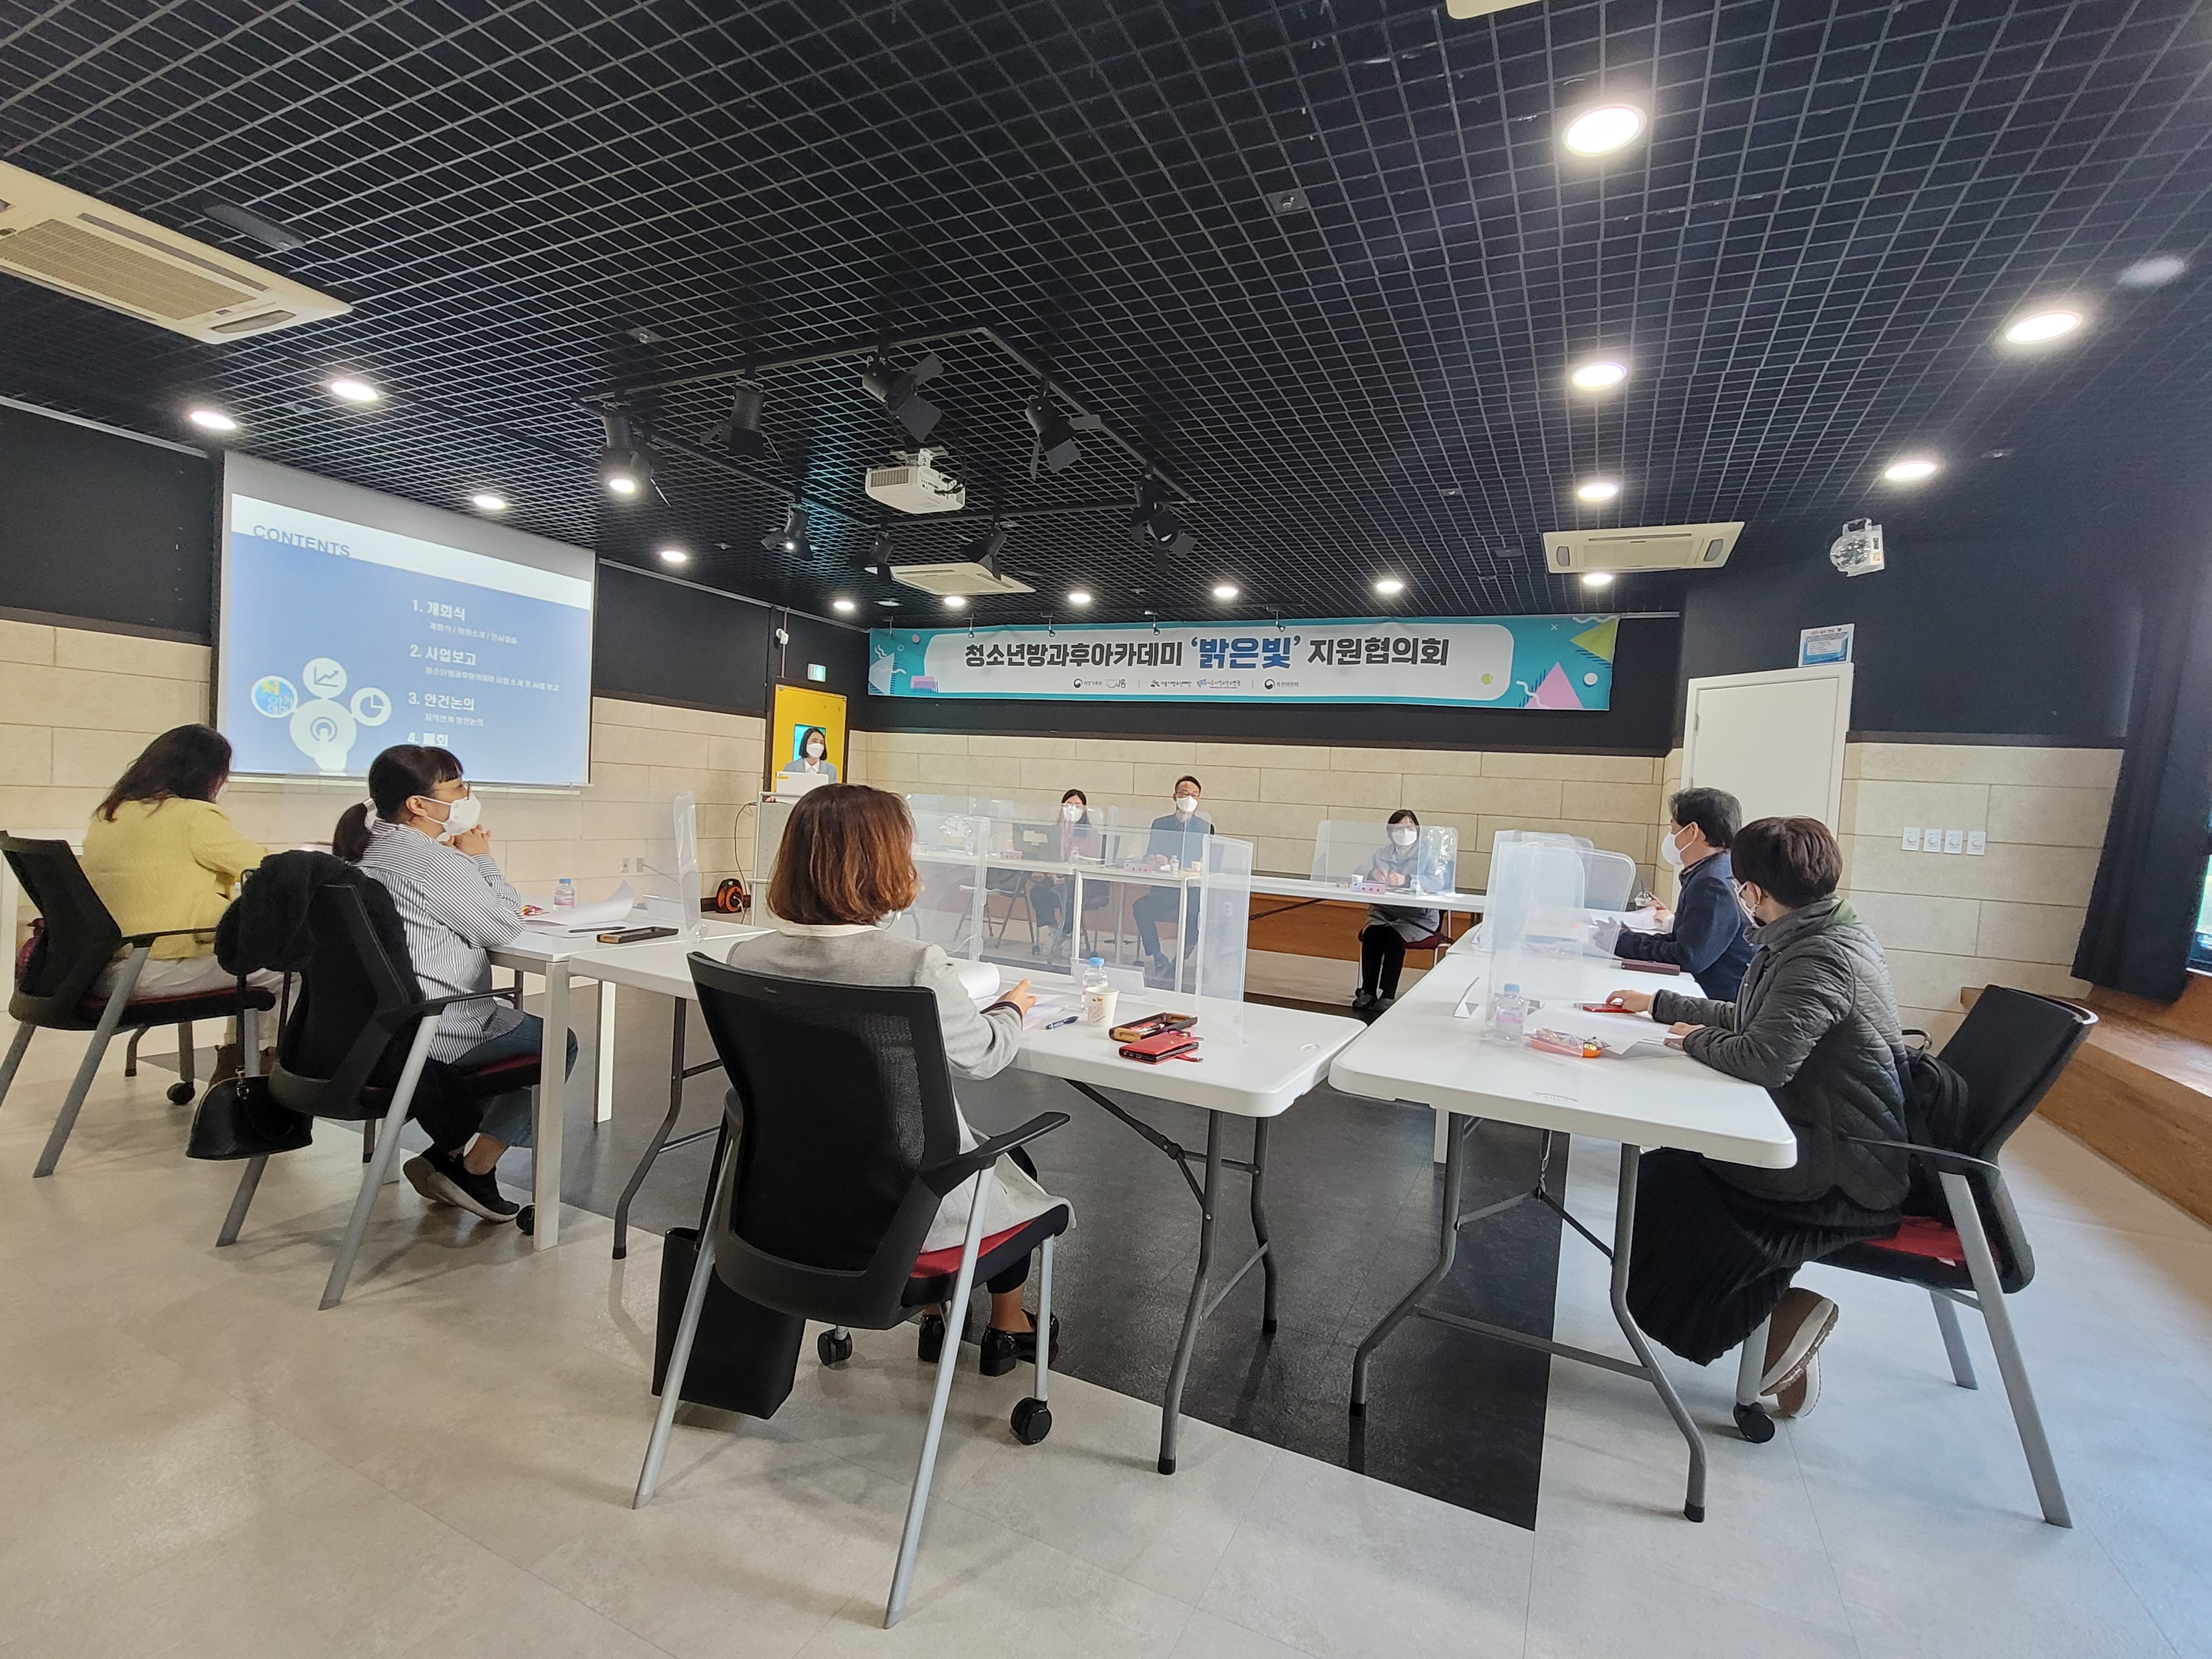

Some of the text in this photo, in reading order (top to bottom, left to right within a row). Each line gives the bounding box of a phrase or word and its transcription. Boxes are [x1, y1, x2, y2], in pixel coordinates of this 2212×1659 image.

[253, 525, 350, 557] CONTENTS
[412, 599, 466, 622] 1. 개회식
[410, 644, 476, 665] 2. 사업보고
[964, 641, 1183, 667] 청소년방과후아카데미
[1307, 637, 1450, 666] 지원협의회
[408, 692, 474, 711] 3. 안건논의
[407, 732, 419, 744] 4.
